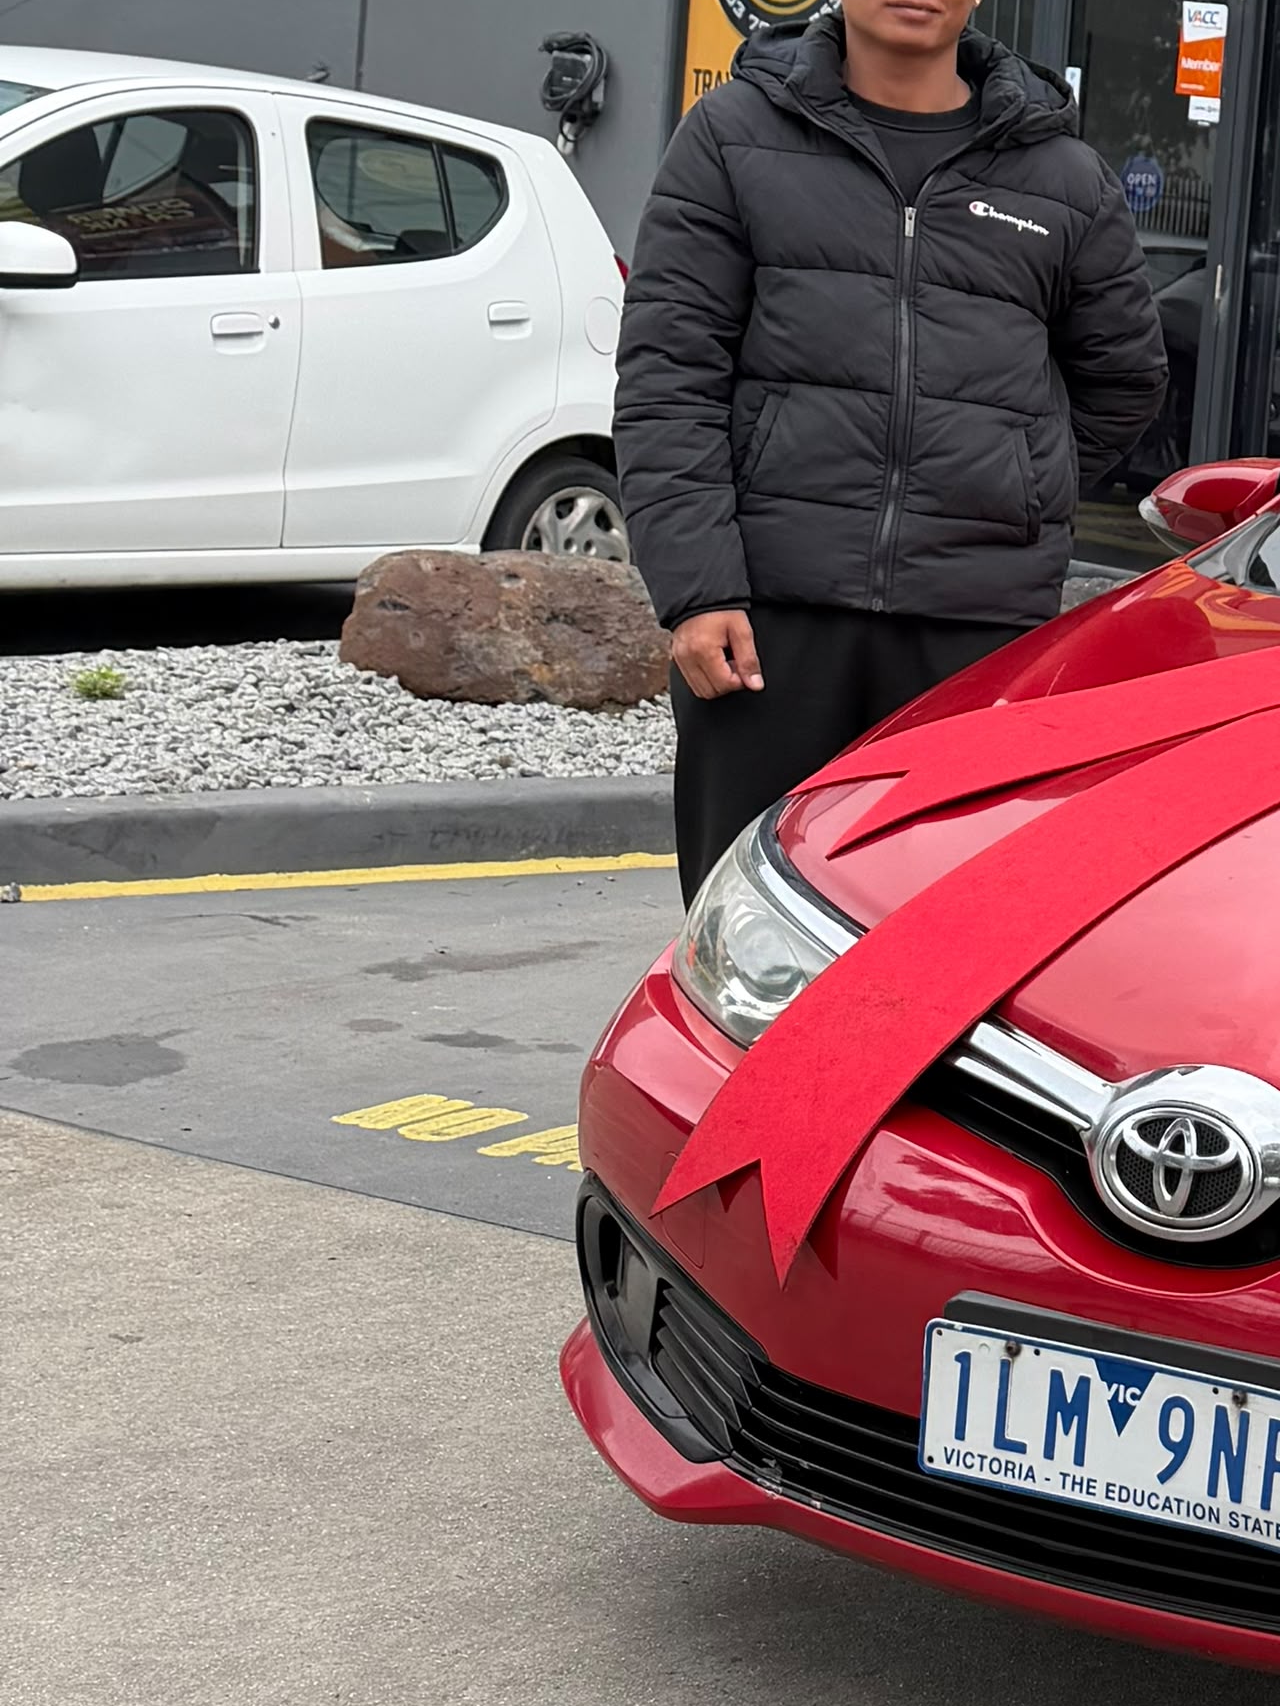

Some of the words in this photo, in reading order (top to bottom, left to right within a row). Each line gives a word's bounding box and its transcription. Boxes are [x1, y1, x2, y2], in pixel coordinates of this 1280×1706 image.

[1187, 9, 1220, 25] VACC
[1127, 172, 1157, 185] OPEN
[969, 200, 1050, 236] Champion
[943, 1446, 1037, 1485] VICTORIA
[1059, 1473, 1098, 1497] THE
[1105, 1483, 1221, 1527] EDUCATION
